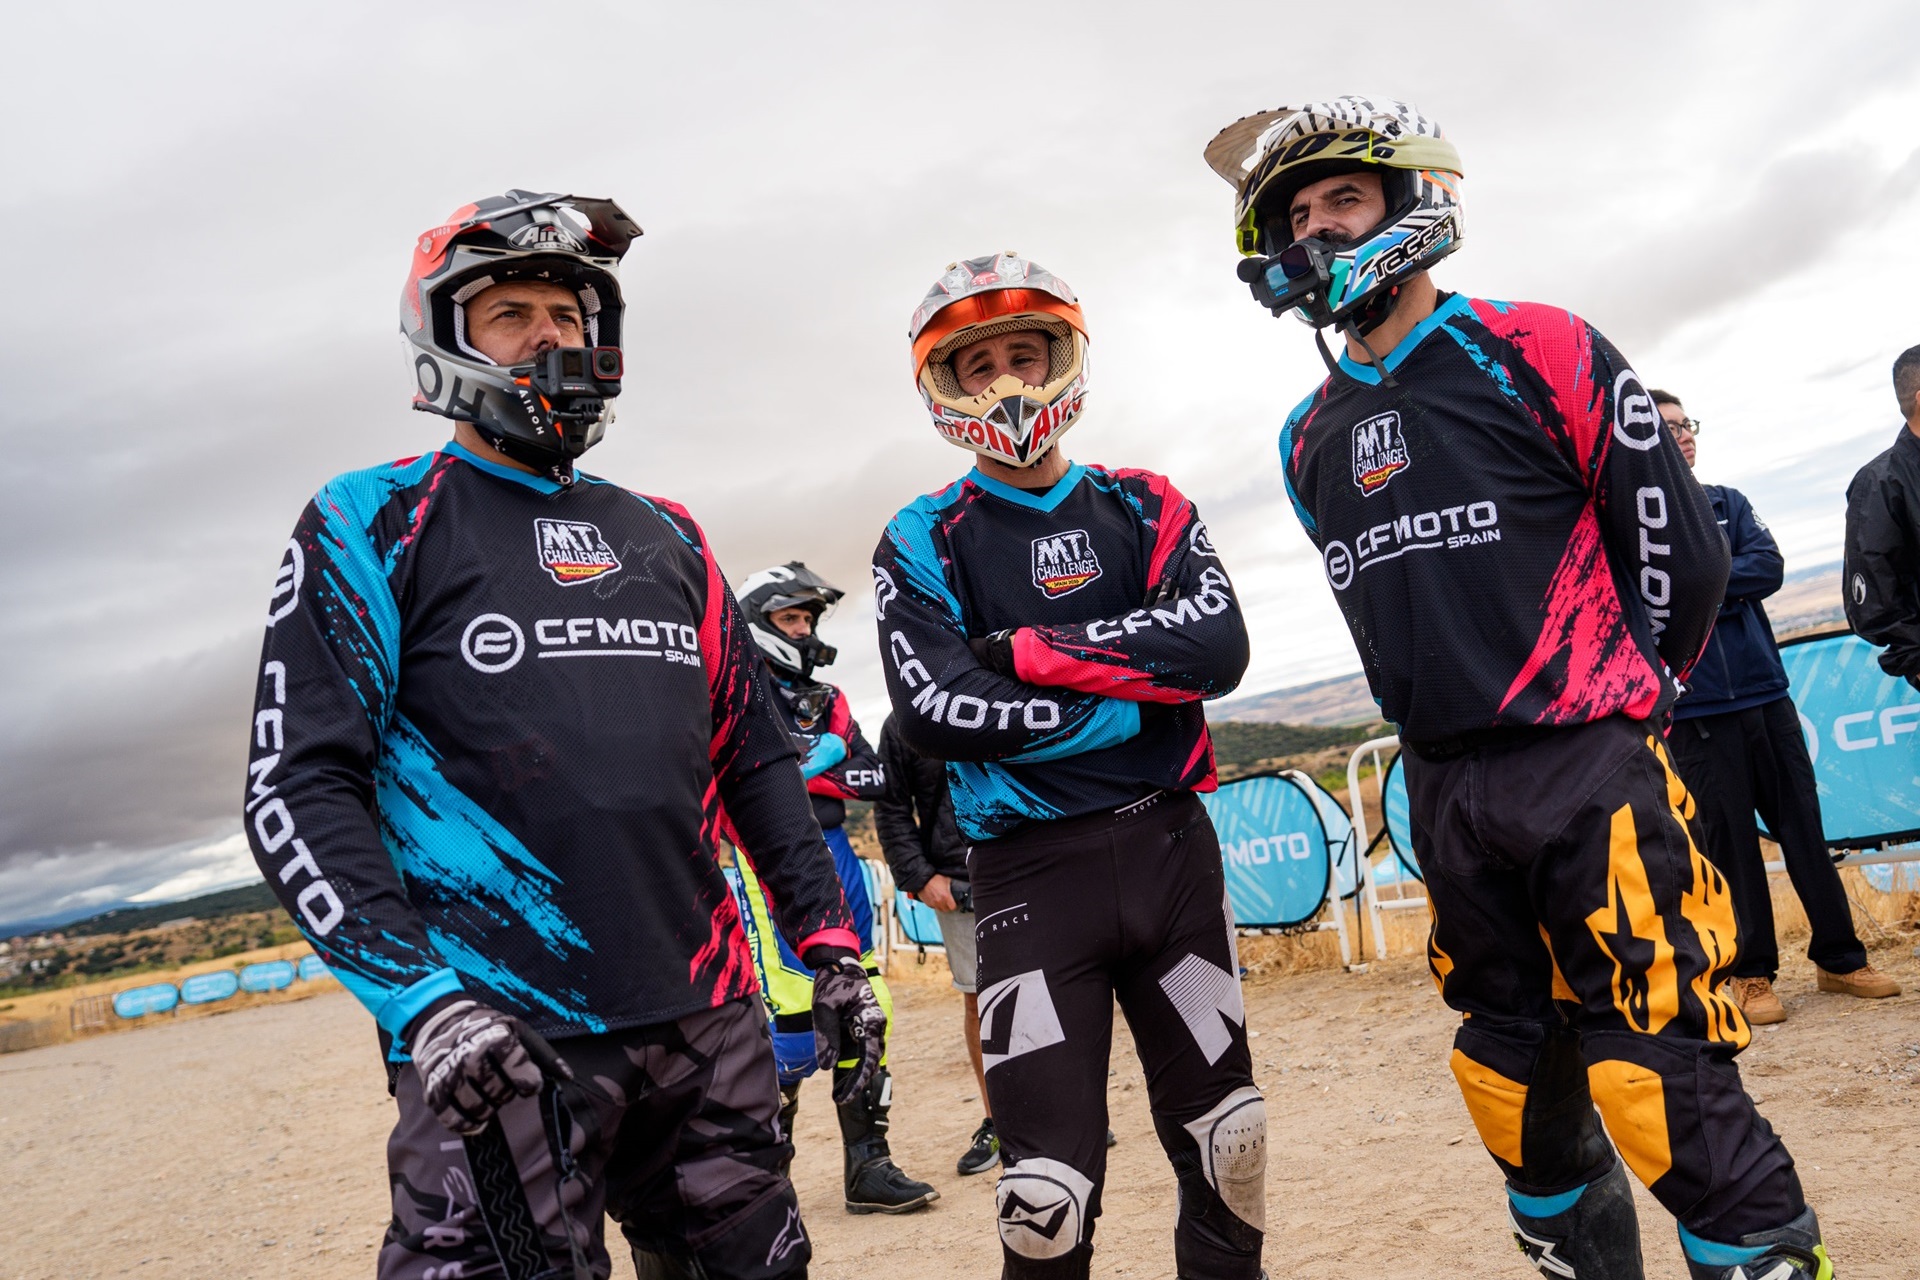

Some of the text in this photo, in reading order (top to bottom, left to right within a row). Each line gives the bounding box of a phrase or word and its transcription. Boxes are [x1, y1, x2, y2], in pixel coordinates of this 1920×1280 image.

[432, 227, 451, 239] AIROH
[518, 226, 583, 251] Airoh
[519, 389, 545, 435] AIROH
[1356, 416, 1396, 462] MT
[541, 522, 594, 552] MT
[1354, 500, 1498, 559] CFMOTO
[1447, 528, 1501, 550] SPAIN
[543, 549, 615, 566] CHALLENGE
[1037, 533, 1084, 567] MT
[1036, 559, 1097, 581] CHALLENGE
[535, 617, 698, 652] CFMOTO
[664, 650, 701, 668] SPAIN
[891, 630, 1060, 730] CFMOTO
[1834, 703, 1920, 752] CF
[992, 913, 1029, 931] RACE
[1214, 1135, 1265, 1155] RIDER
